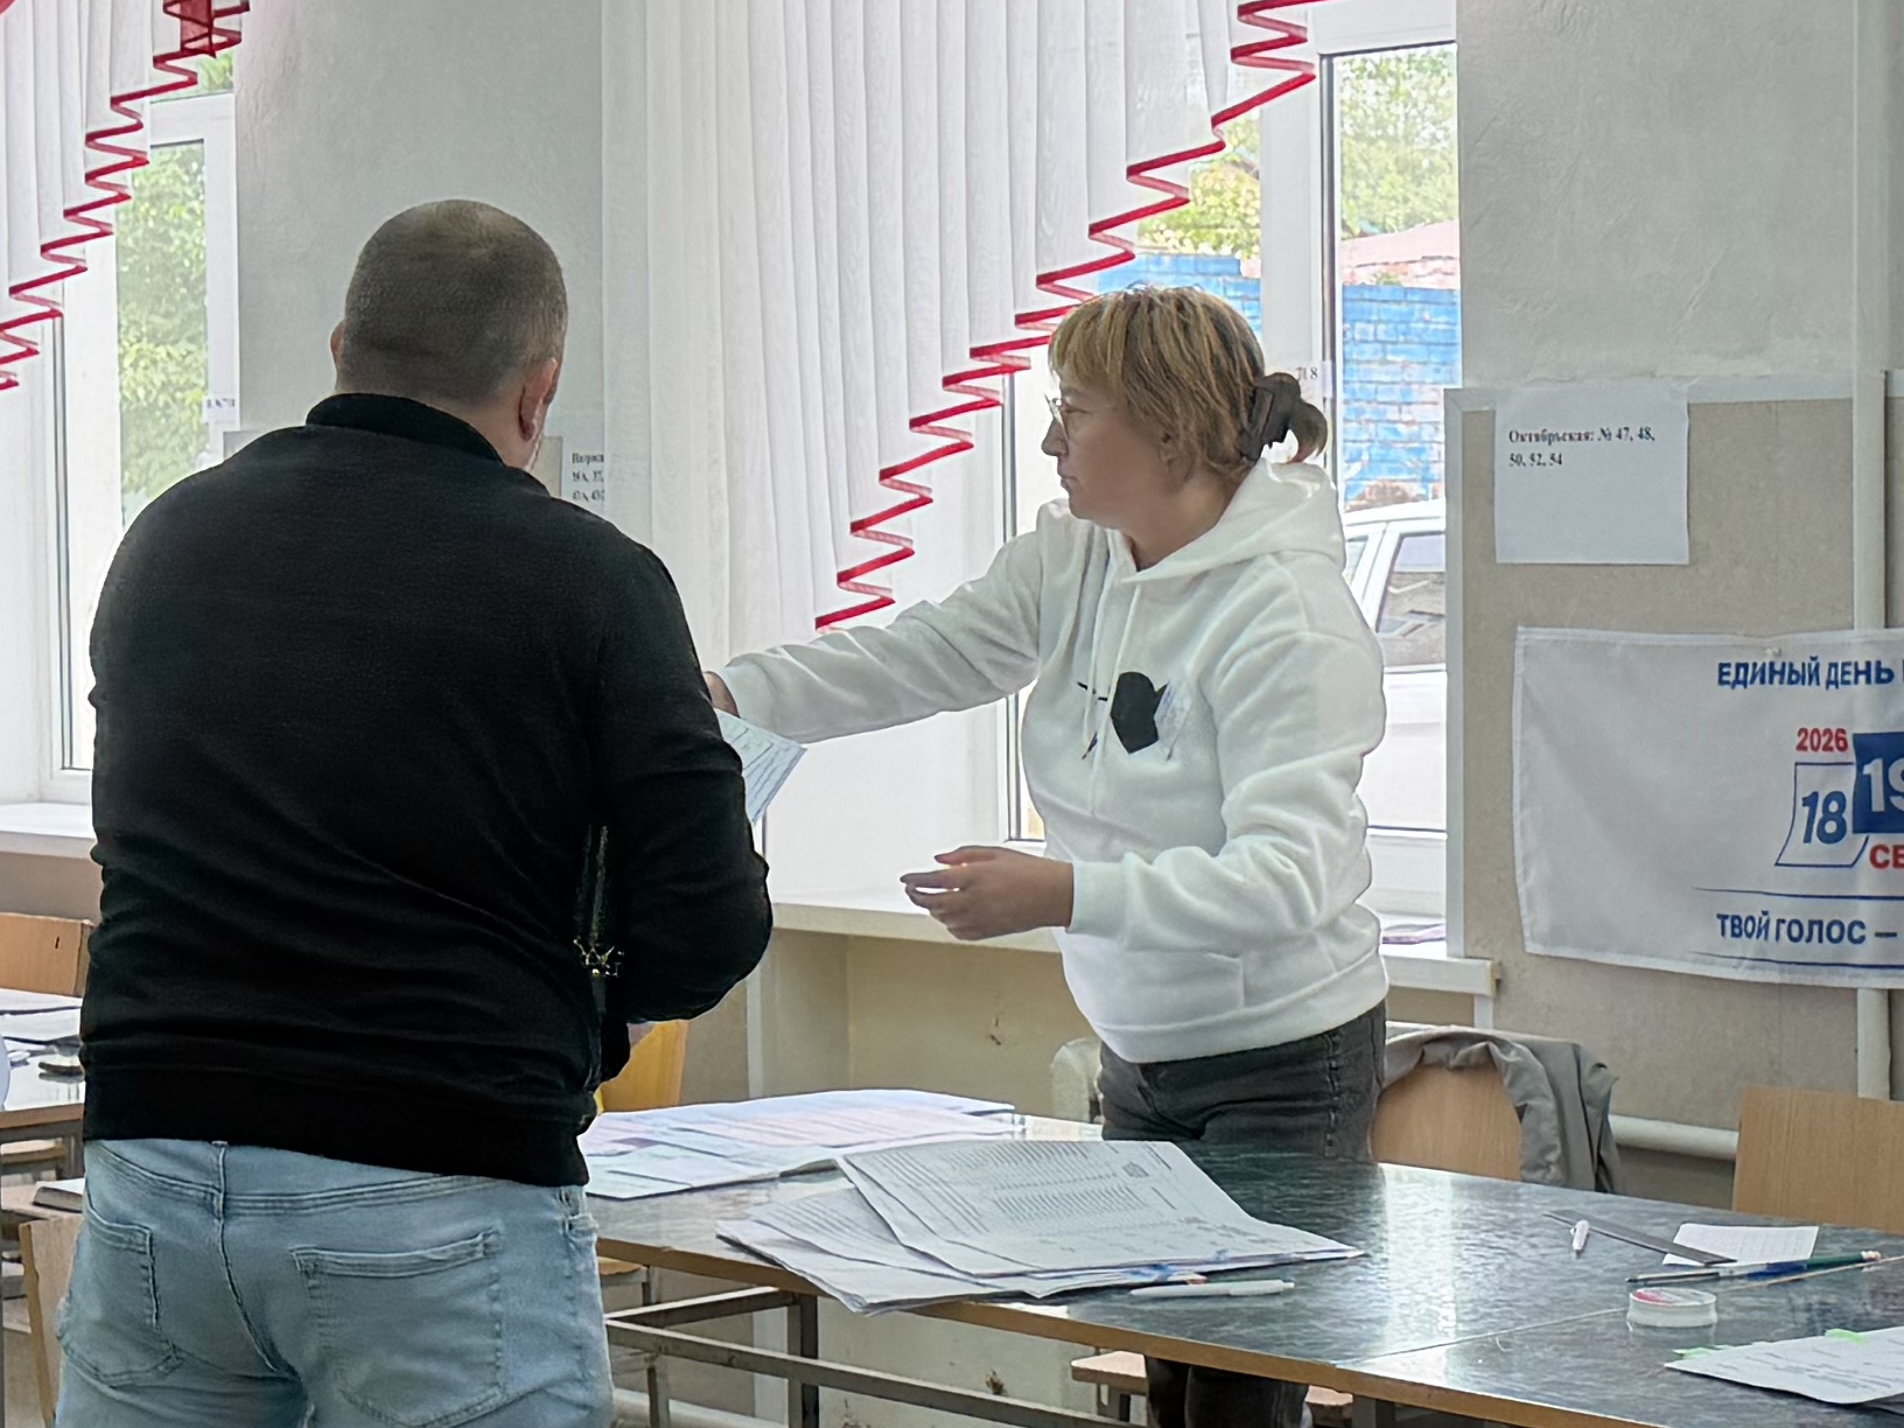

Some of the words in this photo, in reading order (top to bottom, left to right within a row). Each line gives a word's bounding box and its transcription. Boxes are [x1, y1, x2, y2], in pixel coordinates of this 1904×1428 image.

[1717, 655, 1821, 690] ЕДИНЫЙ
[1825, 659, 1895, 690] ДЕНЬ
[1796, 726, 1849, 753] 2026
[1801, 790, 1847, 845] 18
[1716, 910, 1771, 942] ТВОЙ
[1775, 918, 1867, 945] ГОЛОС
